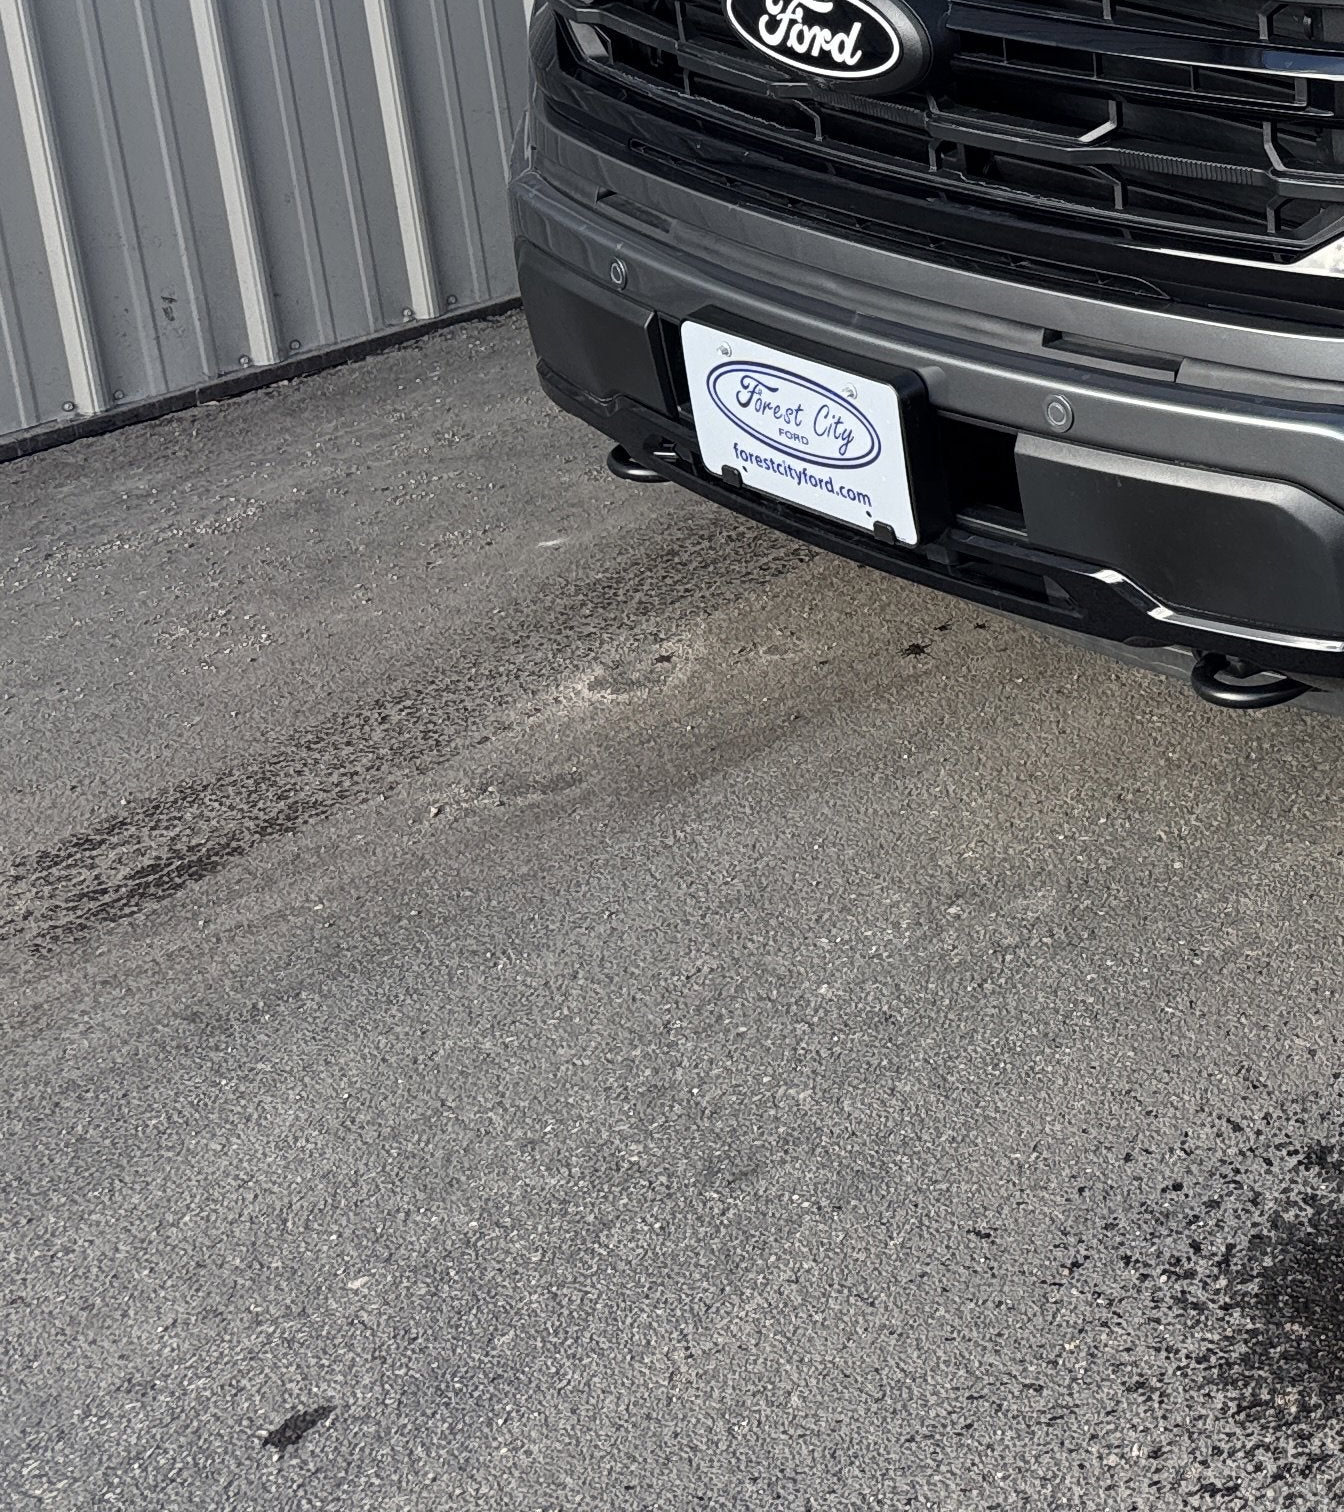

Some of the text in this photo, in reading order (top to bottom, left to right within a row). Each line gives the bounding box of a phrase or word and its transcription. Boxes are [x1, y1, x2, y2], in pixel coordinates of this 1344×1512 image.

[736, 375, 855, 456] Forest City
[779, 428, 810, 445] FORD
[733, 442, 873, 507] forestcityford.com
